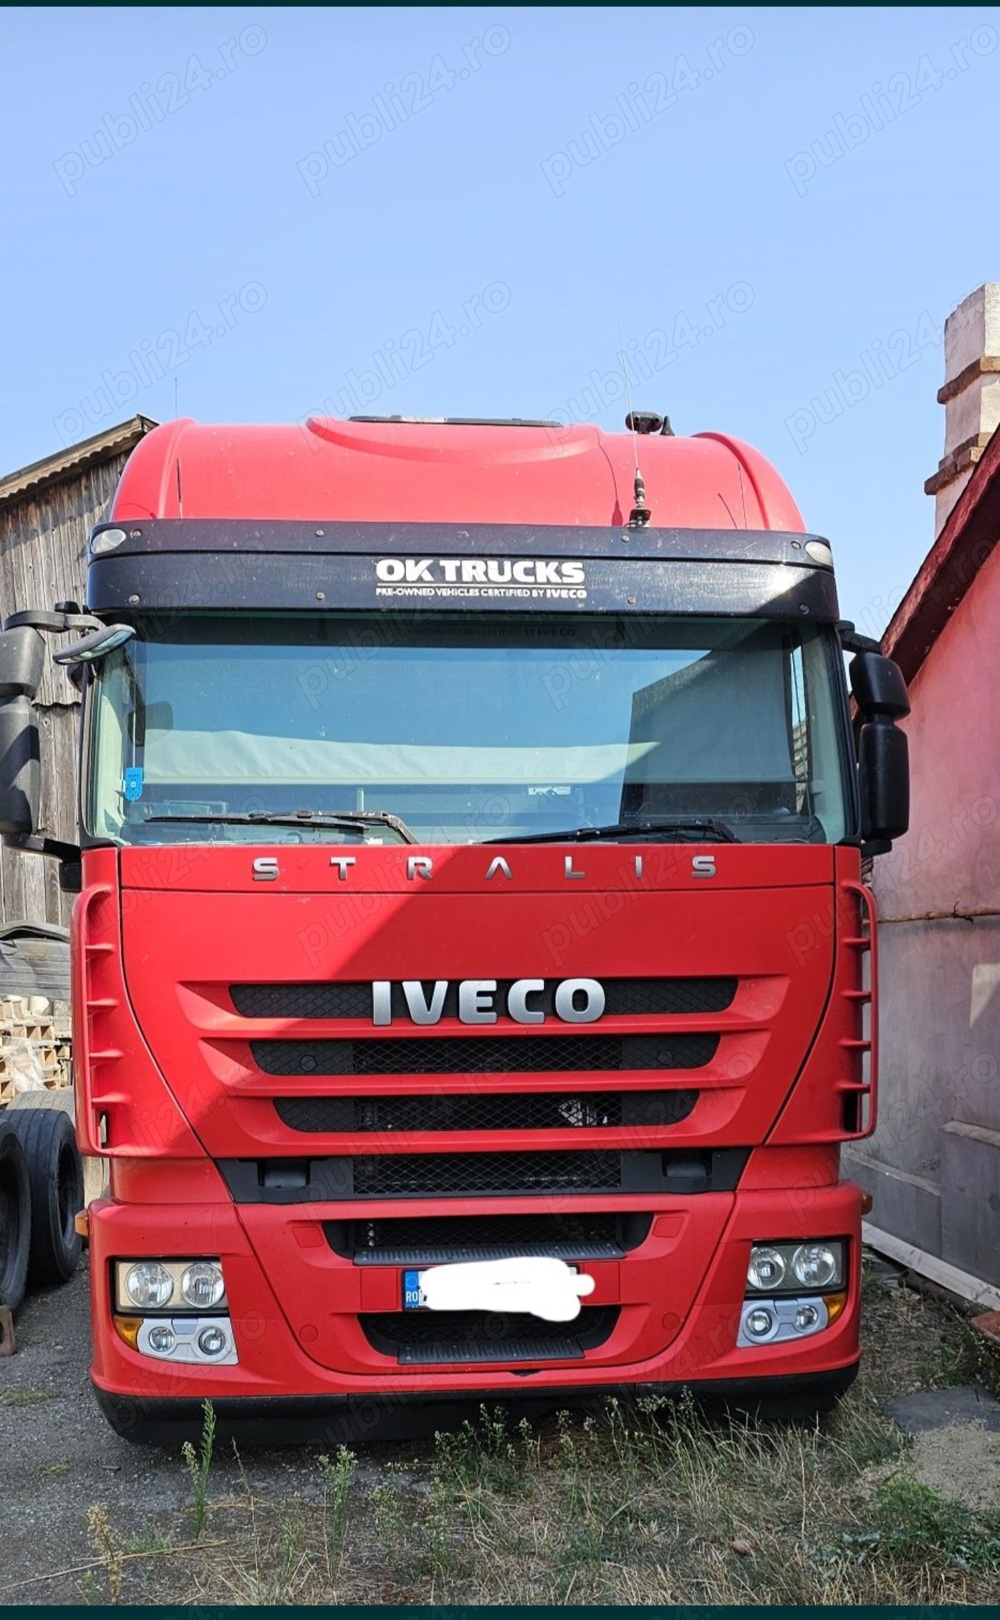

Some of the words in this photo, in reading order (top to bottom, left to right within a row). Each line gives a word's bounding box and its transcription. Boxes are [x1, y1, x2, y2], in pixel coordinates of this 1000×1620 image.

[376, 559, 434, 582] OK
[440, 560, 585, 583] TRUCKS
[376, 588, 435, 596] PRE-OWNED
[436, 588, 480, 596] VEHICLES
[481, 588, 530, 597] CERTIFIED
[532, 589, 544, 598] BY
[546, 589, 587, 599] IVECO
[252, 855, 718, 881] STRALIS
[371, 977, 606, 1027] IVECO
[405, 1291, 418, 1302] RO
